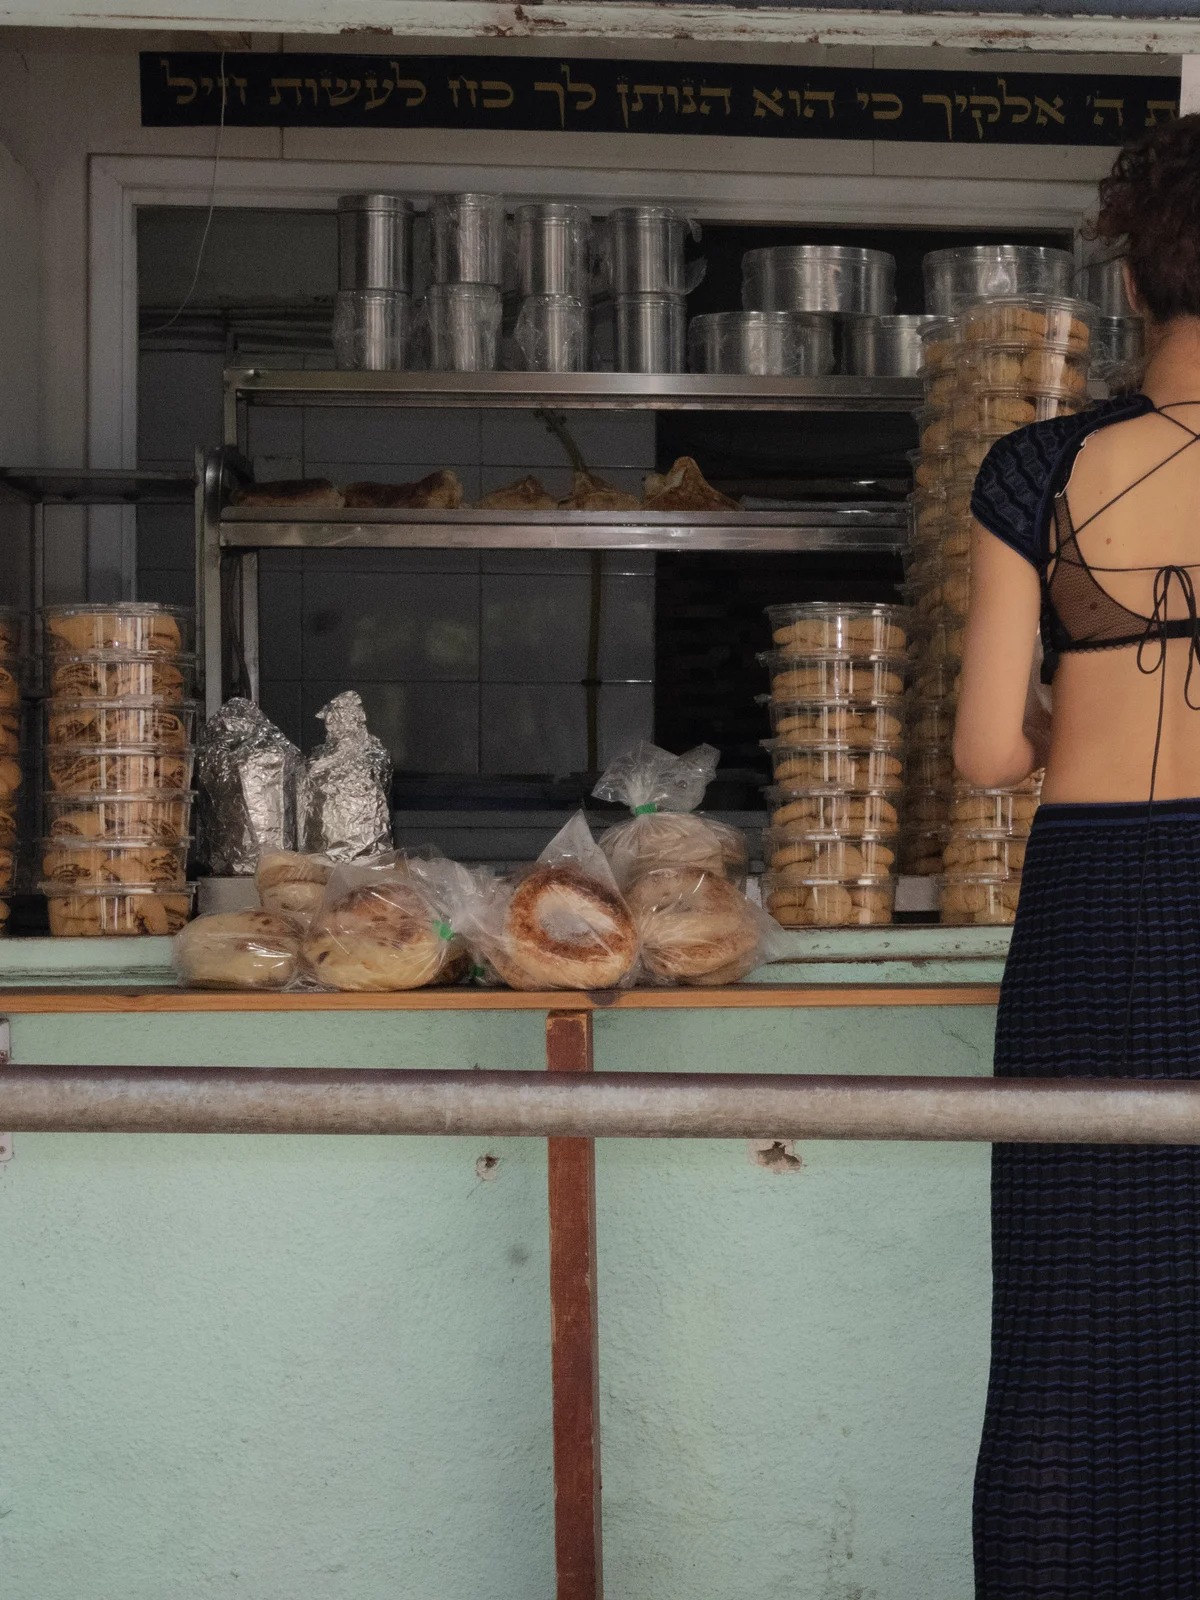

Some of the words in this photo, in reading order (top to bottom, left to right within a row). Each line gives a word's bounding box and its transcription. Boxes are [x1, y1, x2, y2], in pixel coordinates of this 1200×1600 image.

[160, 58, 248, 105] חיל
[269, 60, 427, 110] לעשות
[534, 62, 597, 130] לך
[616, 74, 732, 129] הנותן
[753, 83, 836, 119] הוא
[856, 87, 903, 120] כי
[921, 76, 1065, 141] אלקיך
